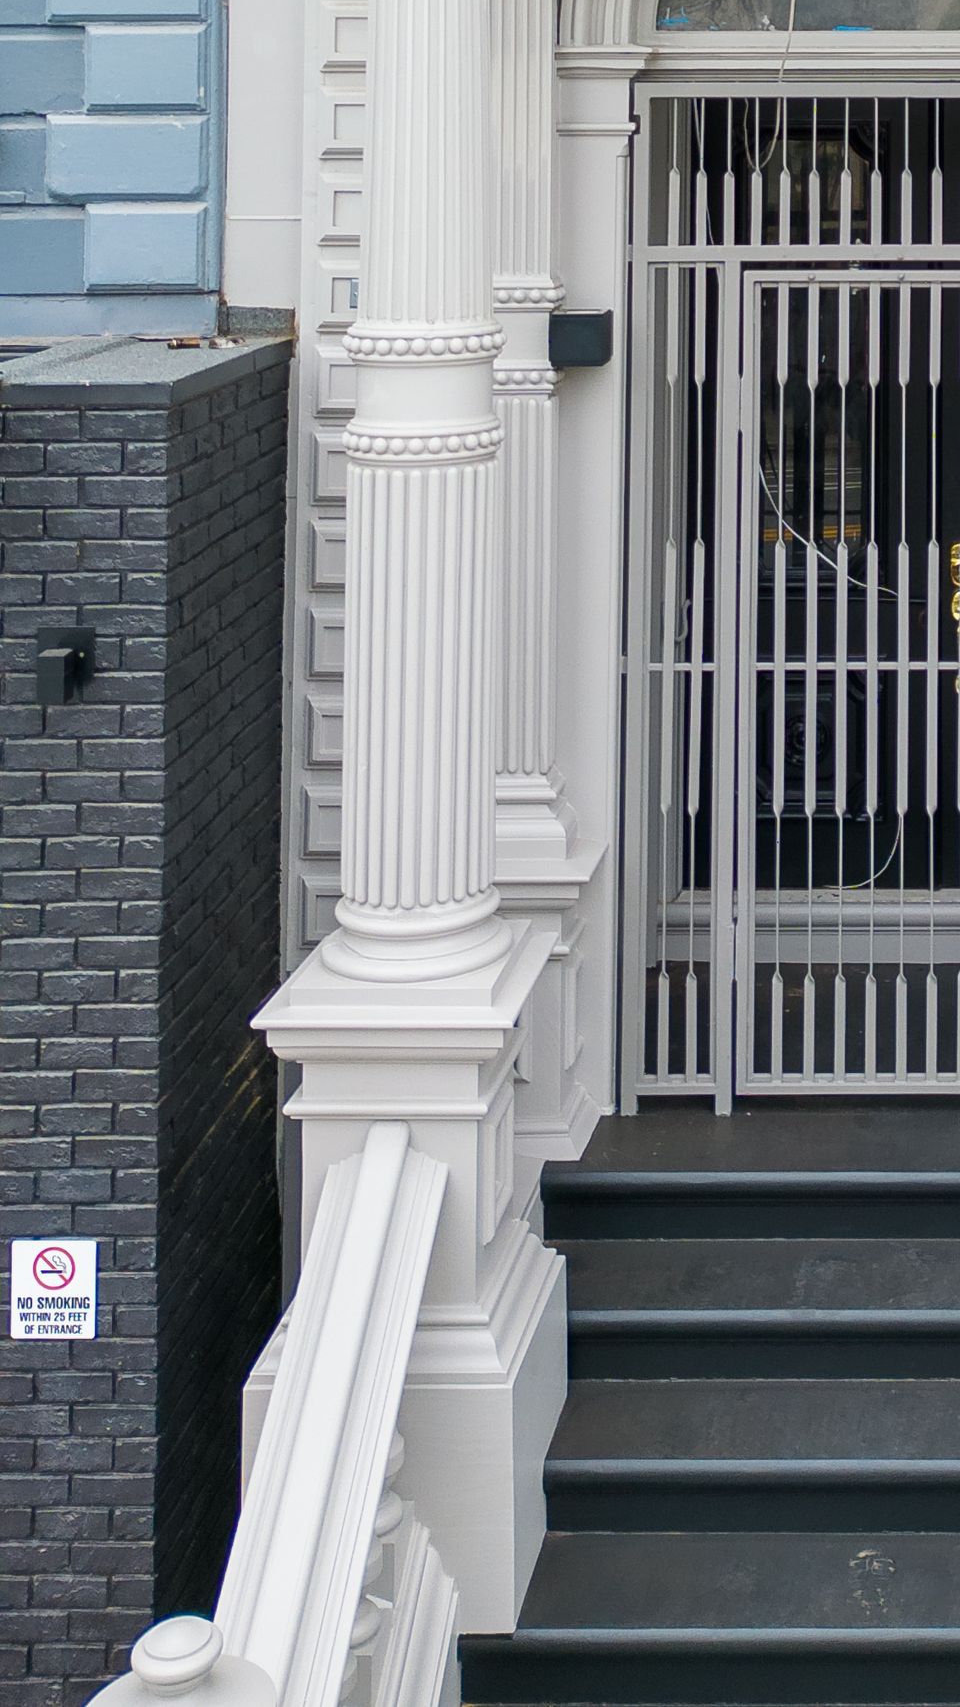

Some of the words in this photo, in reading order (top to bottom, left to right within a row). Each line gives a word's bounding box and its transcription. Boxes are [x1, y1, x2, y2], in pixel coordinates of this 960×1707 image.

[17, 1296, 33, 1310] NO
[37, 1296, 91, 1310] SMOKING
[19, 1312, 51, 1322] WITHIN
[53, 1312, 66, 1322] 25
[68, 1312, 88, 1322] FEET
[24, 1324, 34, 1335] OF
[37, 1324, 83, 1335] ENTRANCE
